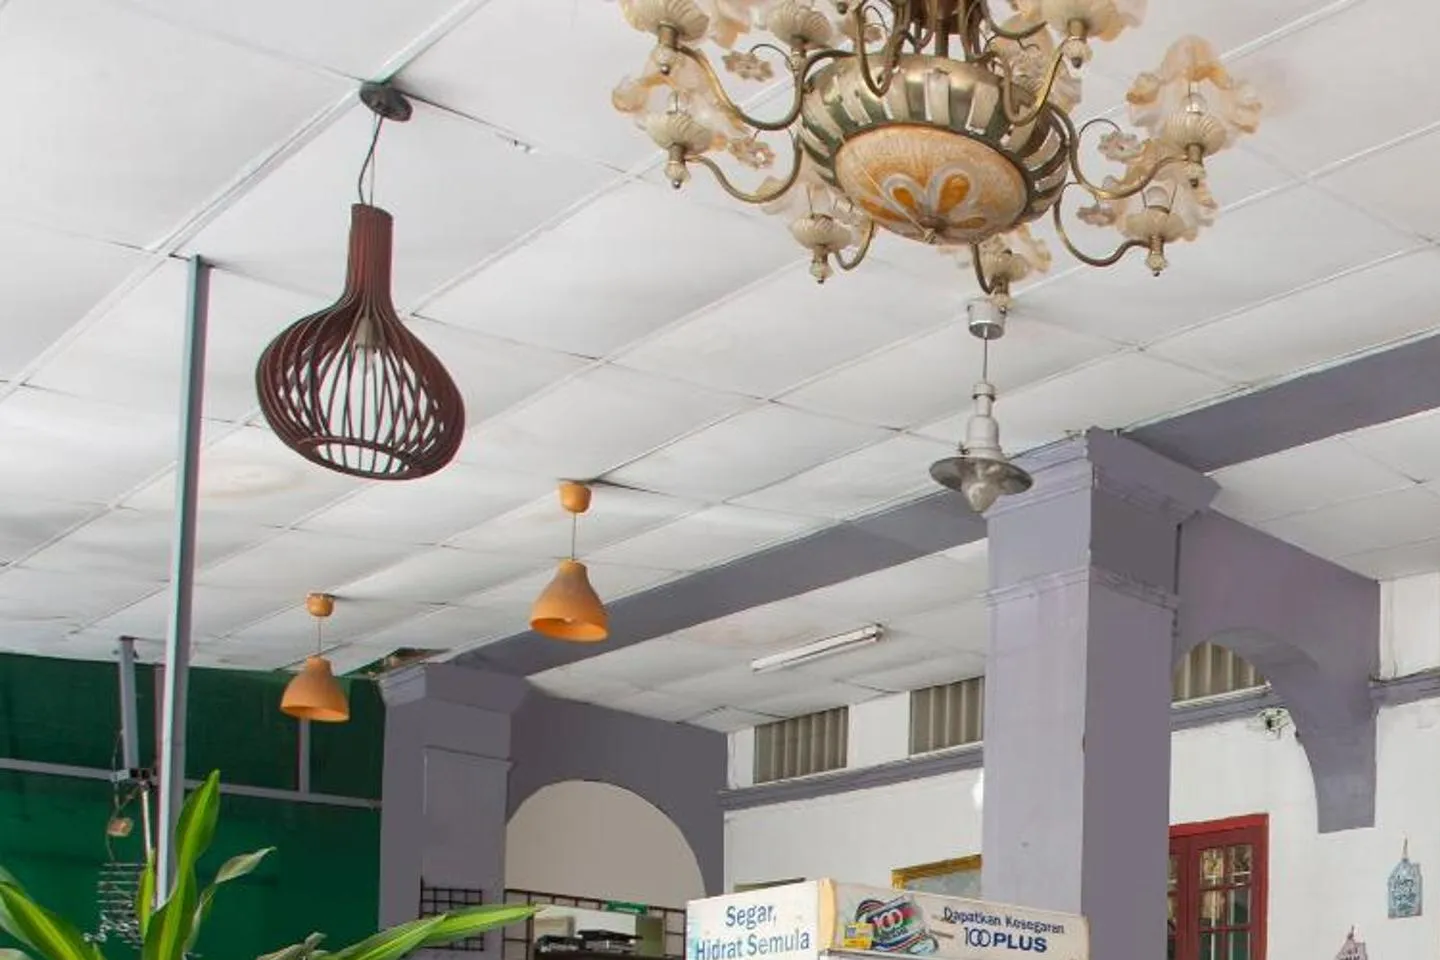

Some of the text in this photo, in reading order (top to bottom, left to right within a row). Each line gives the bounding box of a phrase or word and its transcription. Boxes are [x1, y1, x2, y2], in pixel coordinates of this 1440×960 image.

[943, 905, 1064, 934] Dapatkan Kesegaran
[746, 927, 810, 957] Semula
